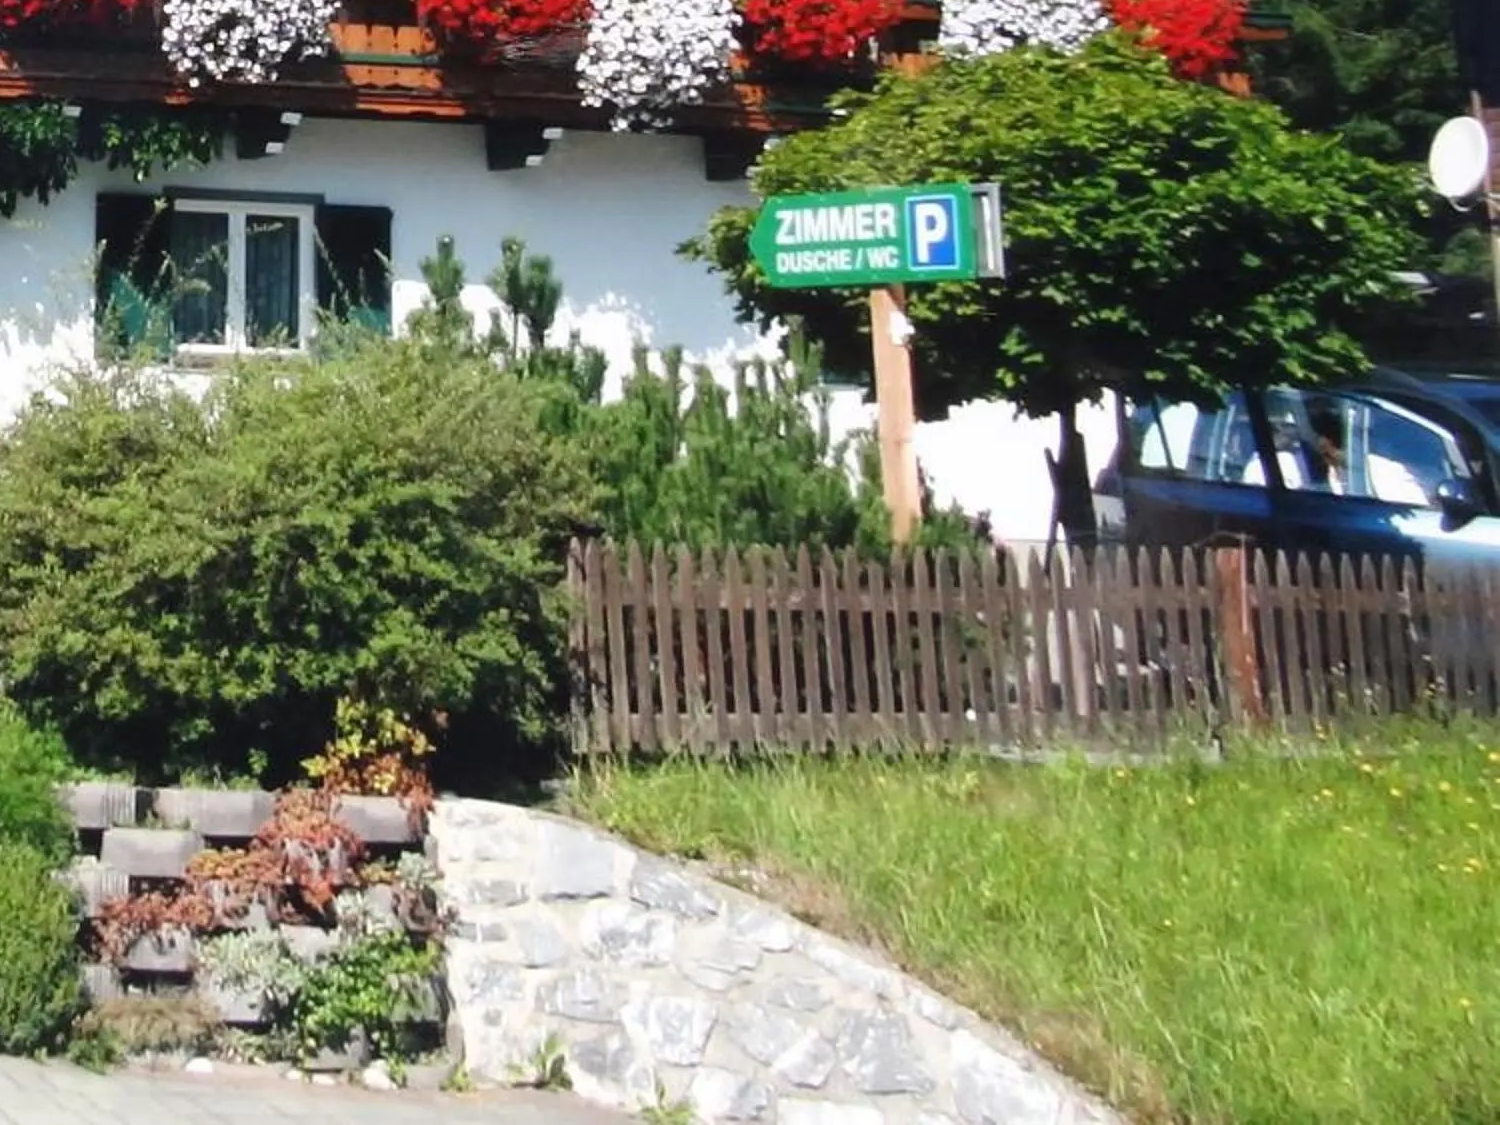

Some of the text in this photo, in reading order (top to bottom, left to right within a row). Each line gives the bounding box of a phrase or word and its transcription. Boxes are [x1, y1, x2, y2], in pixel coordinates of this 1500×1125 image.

[775, 203, 898, 245] ZIMMER
[914, 202, 949, 264] P
[776, 250, 851, 274] DUSCHE
[867, 246, 899, 269] WC
